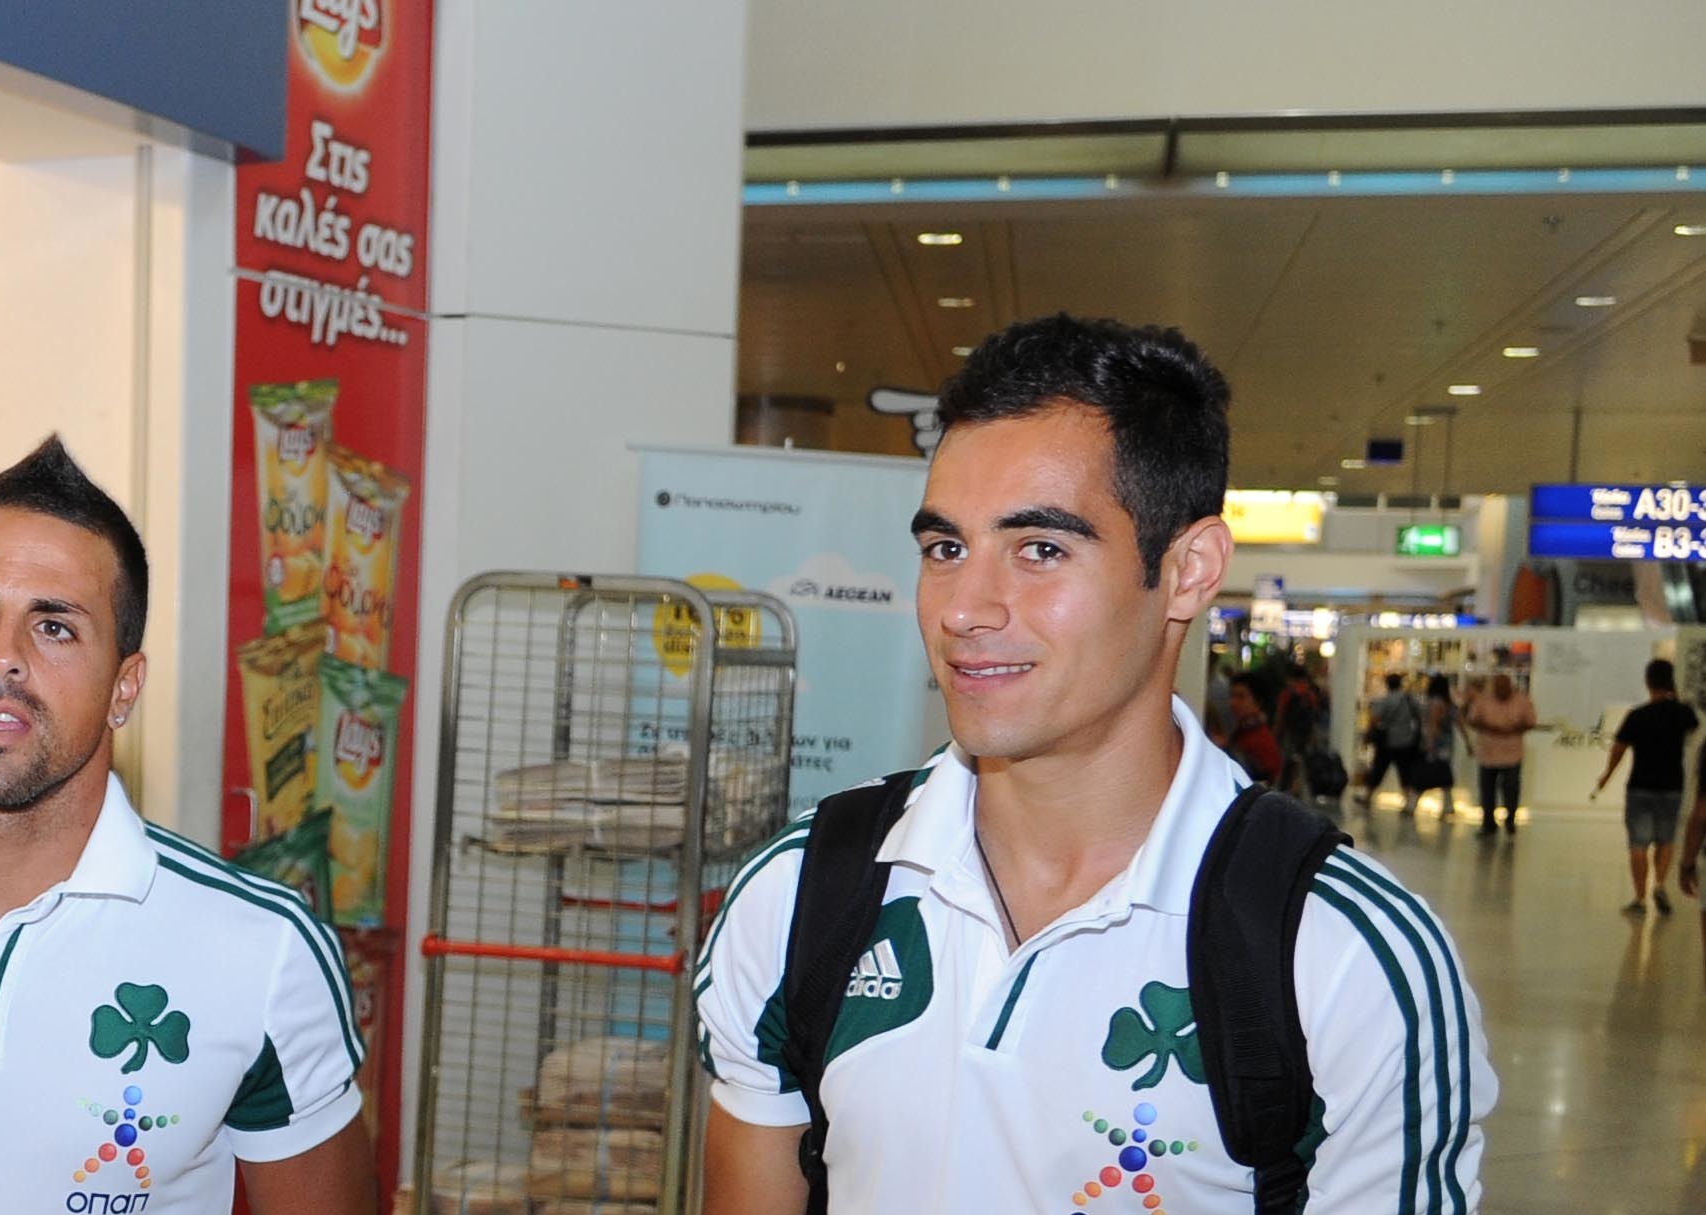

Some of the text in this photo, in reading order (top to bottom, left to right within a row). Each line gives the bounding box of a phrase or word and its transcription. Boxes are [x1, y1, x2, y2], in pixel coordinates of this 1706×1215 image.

[306, 120, 371, 194] Στις
[254, 187, 414, 278] καλές σας
[824, 586, 893, 604] AEGEAN
[845, 974, 903, 1000] dida
